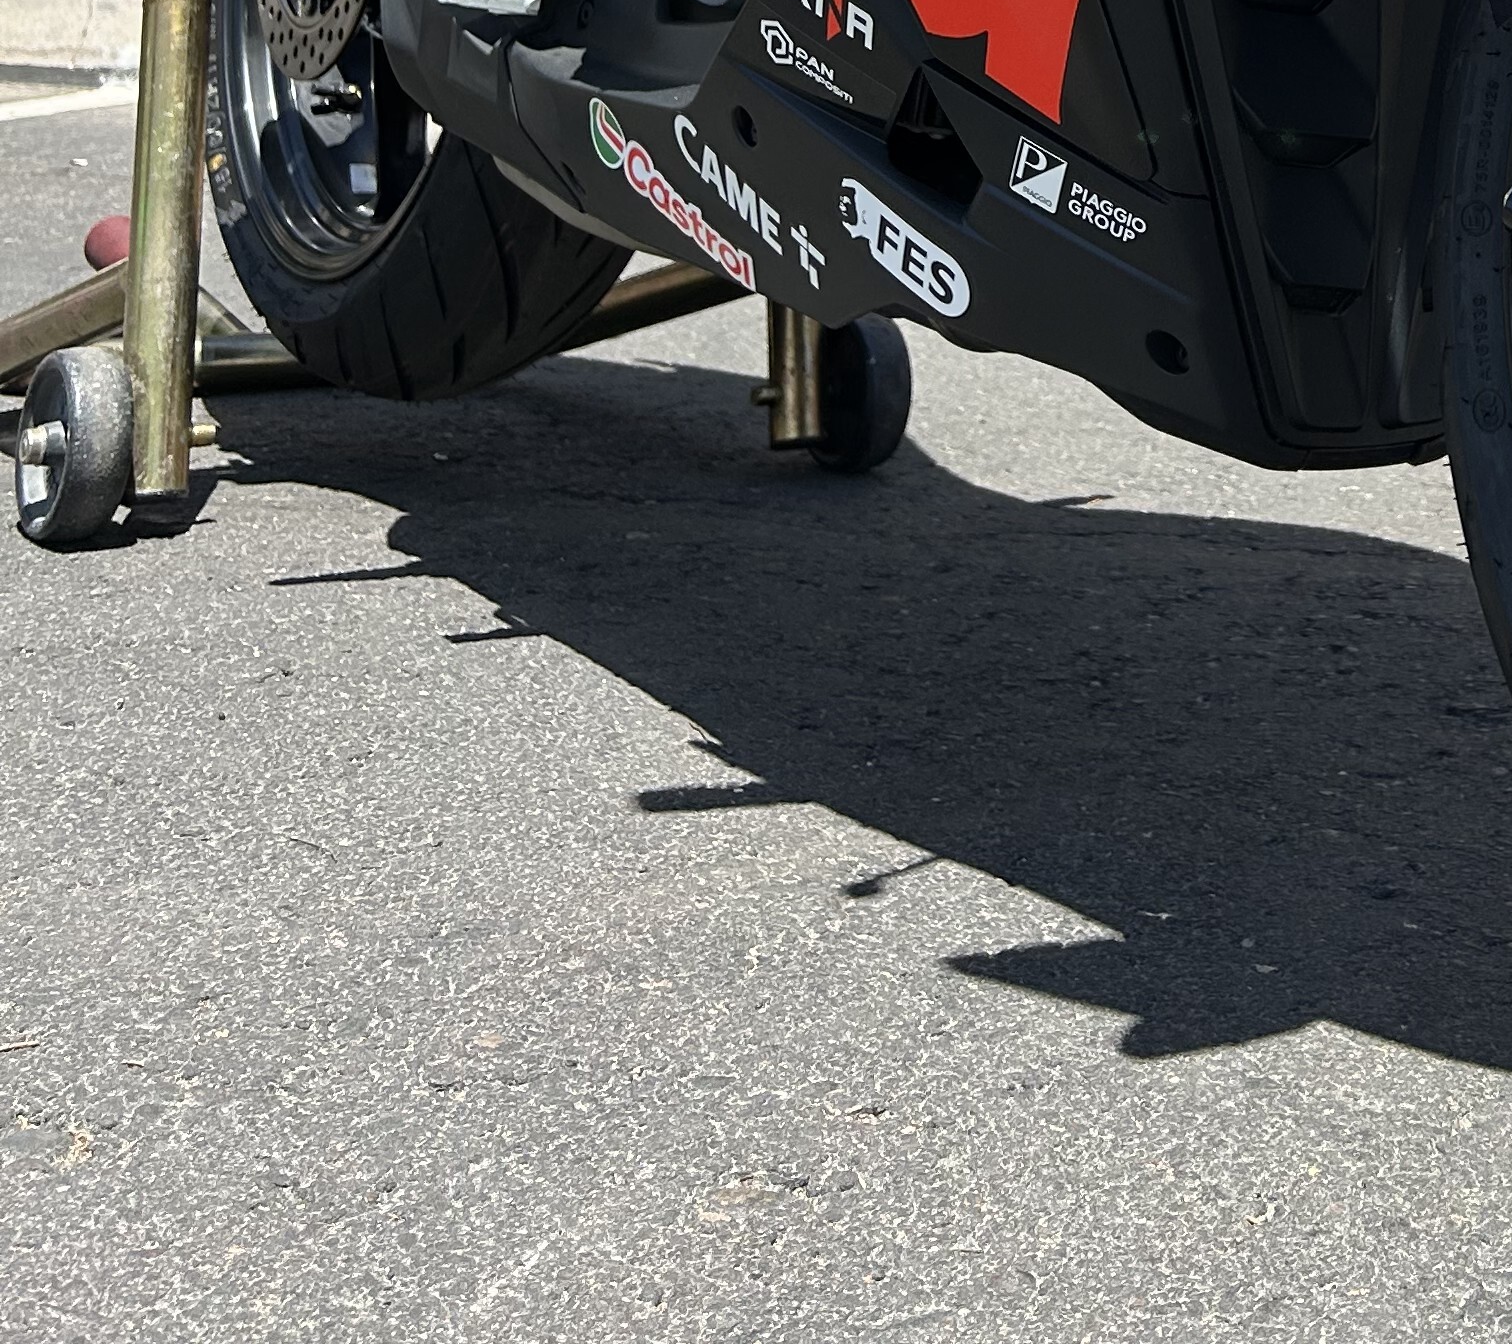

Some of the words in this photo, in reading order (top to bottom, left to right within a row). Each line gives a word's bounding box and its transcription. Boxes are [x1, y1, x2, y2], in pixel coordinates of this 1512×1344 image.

[795, 47, 835, 81] PAN
[625, 141, 758, 291] Castrol
[674, 113, 783, 256] CAME
[1067, 198, 1136, 242] GROUP
[1070, 181, 1147, 234] PIAGGIO
[877, 214, 956, 305] FES
